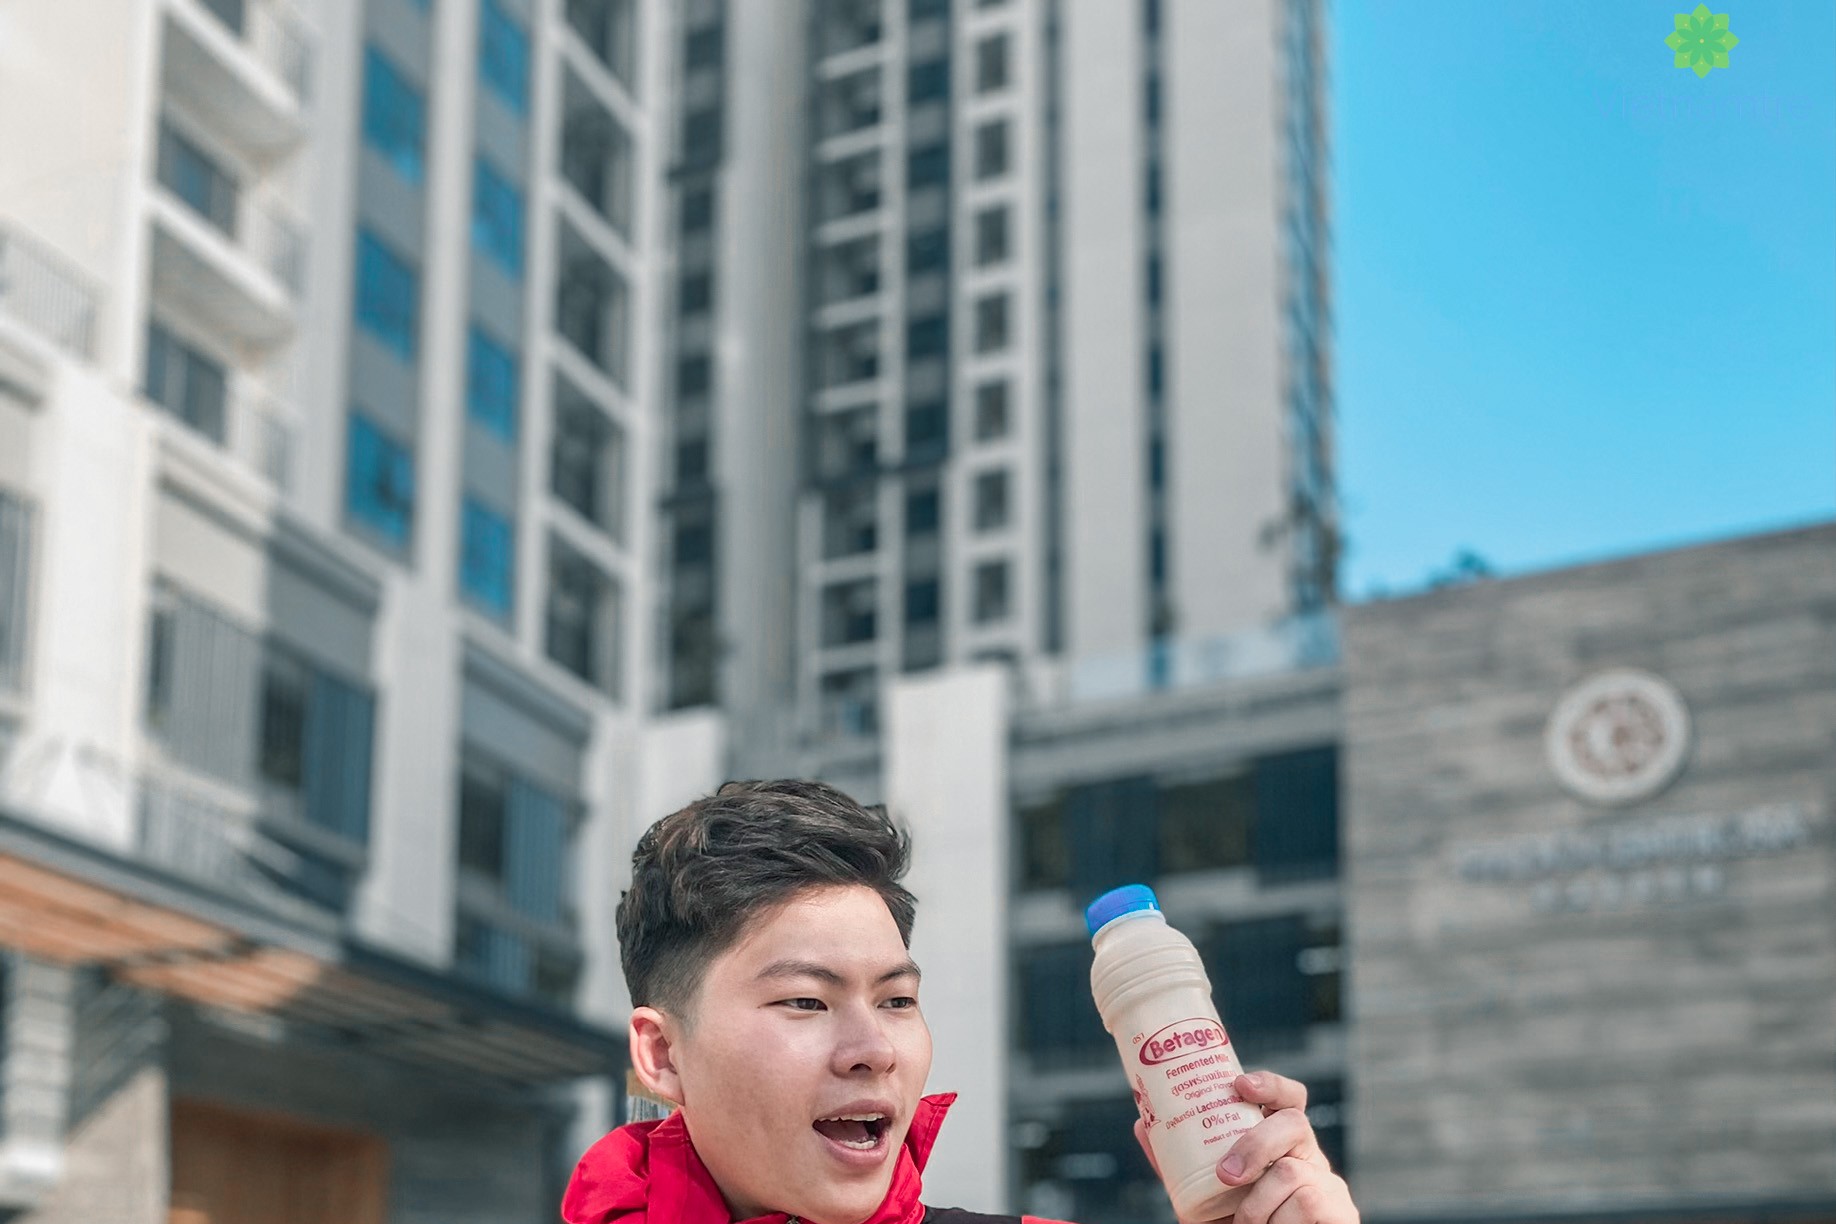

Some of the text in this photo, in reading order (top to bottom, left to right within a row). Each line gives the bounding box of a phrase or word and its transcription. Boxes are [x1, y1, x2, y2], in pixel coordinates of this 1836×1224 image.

[1149, 1028, 1224, 1059] Betagen
[1165, 1055, 1215, 1079] Fermented
[1184, 1084, 1212, 1101] Original
[1202, 1111, 1241, 1129] 0% Fat
[1203, 1133, 1225, 1146] Product
